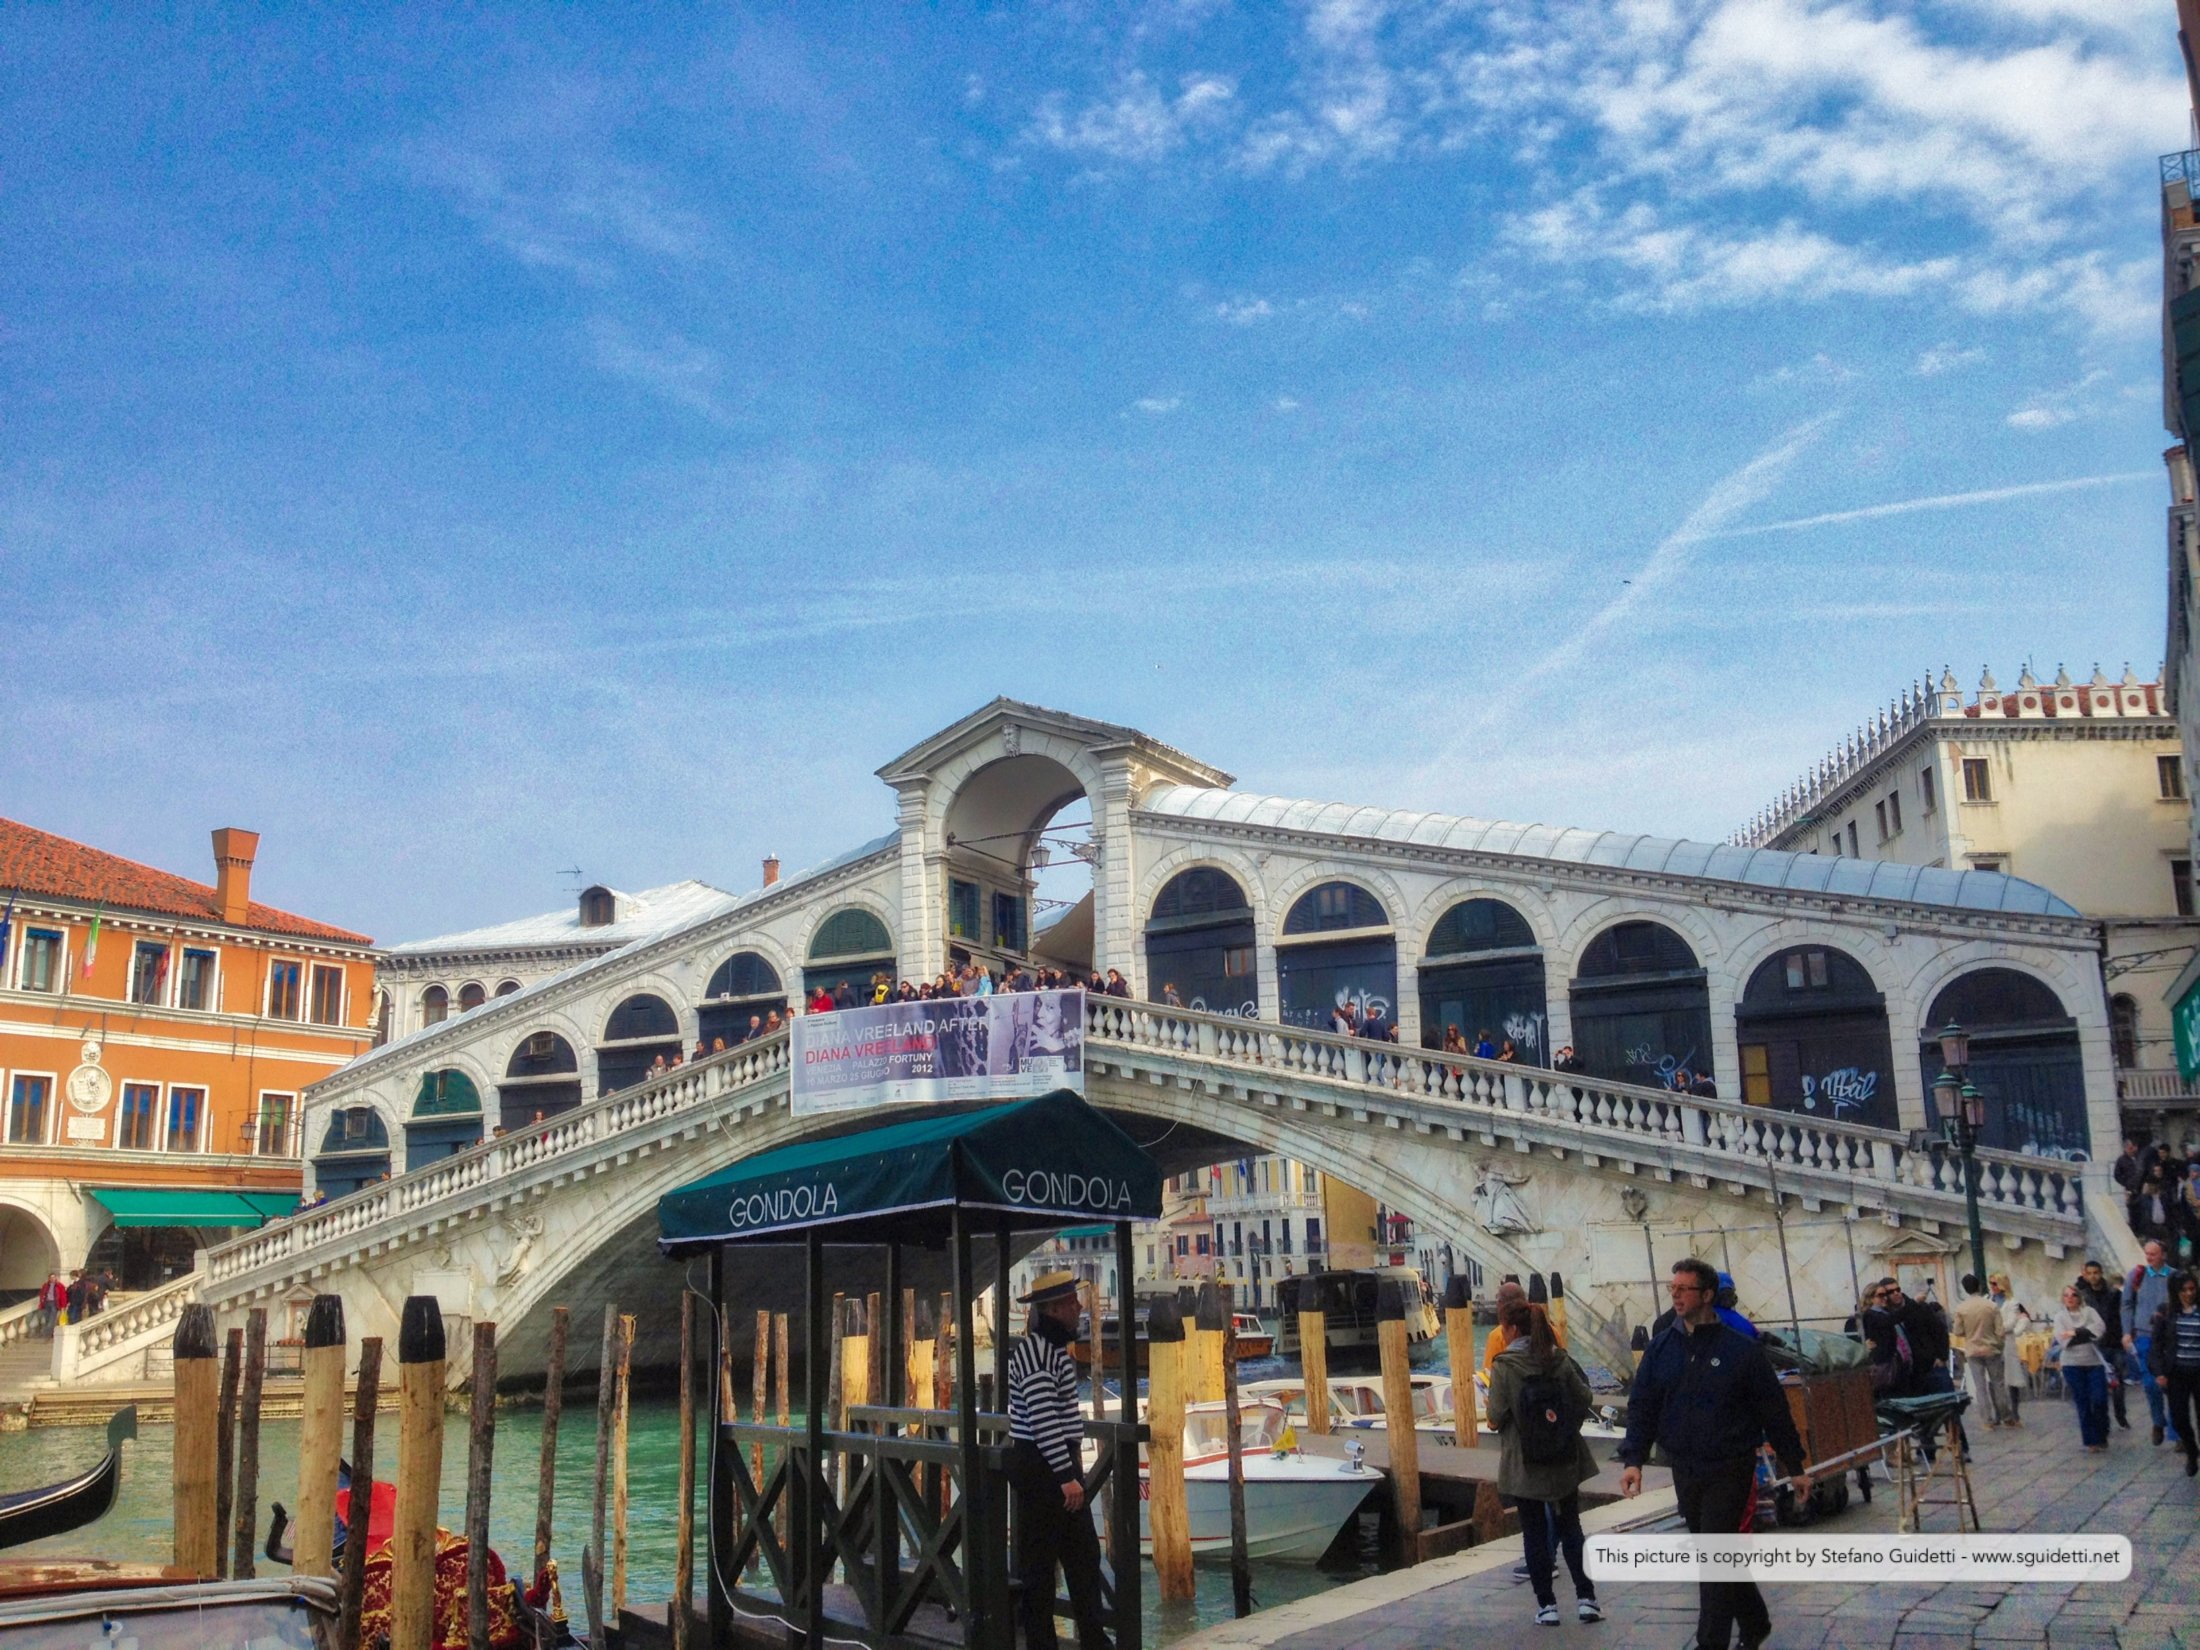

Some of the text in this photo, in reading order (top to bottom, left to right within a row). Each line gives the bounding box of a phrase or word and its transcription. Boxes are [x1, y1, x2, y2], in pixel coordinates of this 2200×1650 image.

[806, 1030, 851, 1048] DIANA
[854, 1020, 936, 1041] VREELAND
[939, 1016, 989, 1033] AFTER
[805, 1046, 851, 1065] DIANA
[806, 1052, 933, 1076] VENEZIA PALAZZO FORTUNY
[816, 1073, 848, 1086] MARZO
[849, 1071, 859, 1081] 25
[911, 1064, 933, 1074] 2012
[1002, 1168, 1132, 1210] GONDOLA
[729, 1182, 838, 1228] GONDOLA
